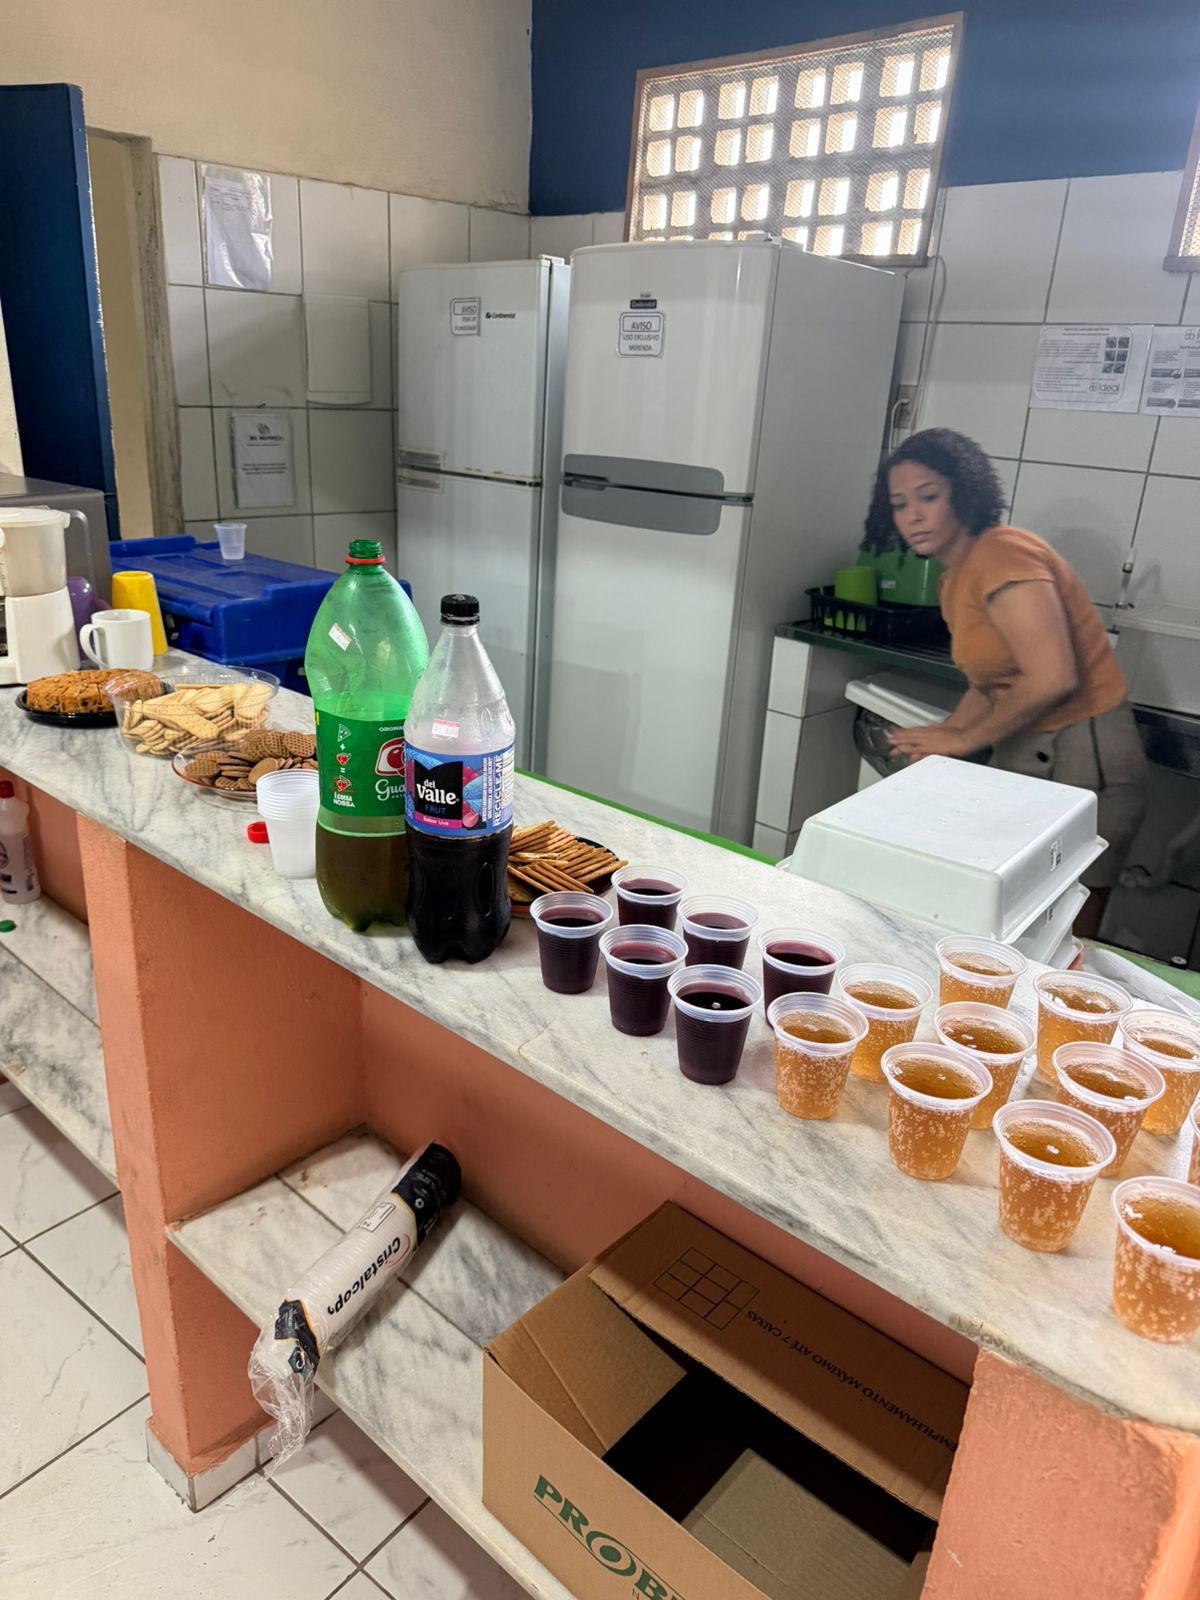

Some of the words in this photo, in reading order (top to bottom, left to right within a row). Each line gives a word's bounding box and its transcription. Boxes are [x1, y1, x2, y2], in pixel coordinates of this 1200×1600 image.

[631, 321, 652, 330] AVISO
[1099, 383, 1120, 392] ideal
[423, 779, 436, 789] del
[416, 784, 457, 805] Valle
[494, 755, 504, 827] RECICLE-ME
[333, 799, 355, 807] NOSSA
[425, 804, 447, 815] FRUT
[423, 816, 437, 825] Sabor
[438, 818, 449, 826] Uva
[746, 1310, 783, 1338] CAIXAS
[782, 1334, 792, 1344] 7
[791, 1341, 813, 1356] ATÉ
[812, 1354, 861, 1390] MÁXIMO
[862, 1386, 959, 1451] EMPILHAMENTO
[534, 1474, 682, 1600] PROB
